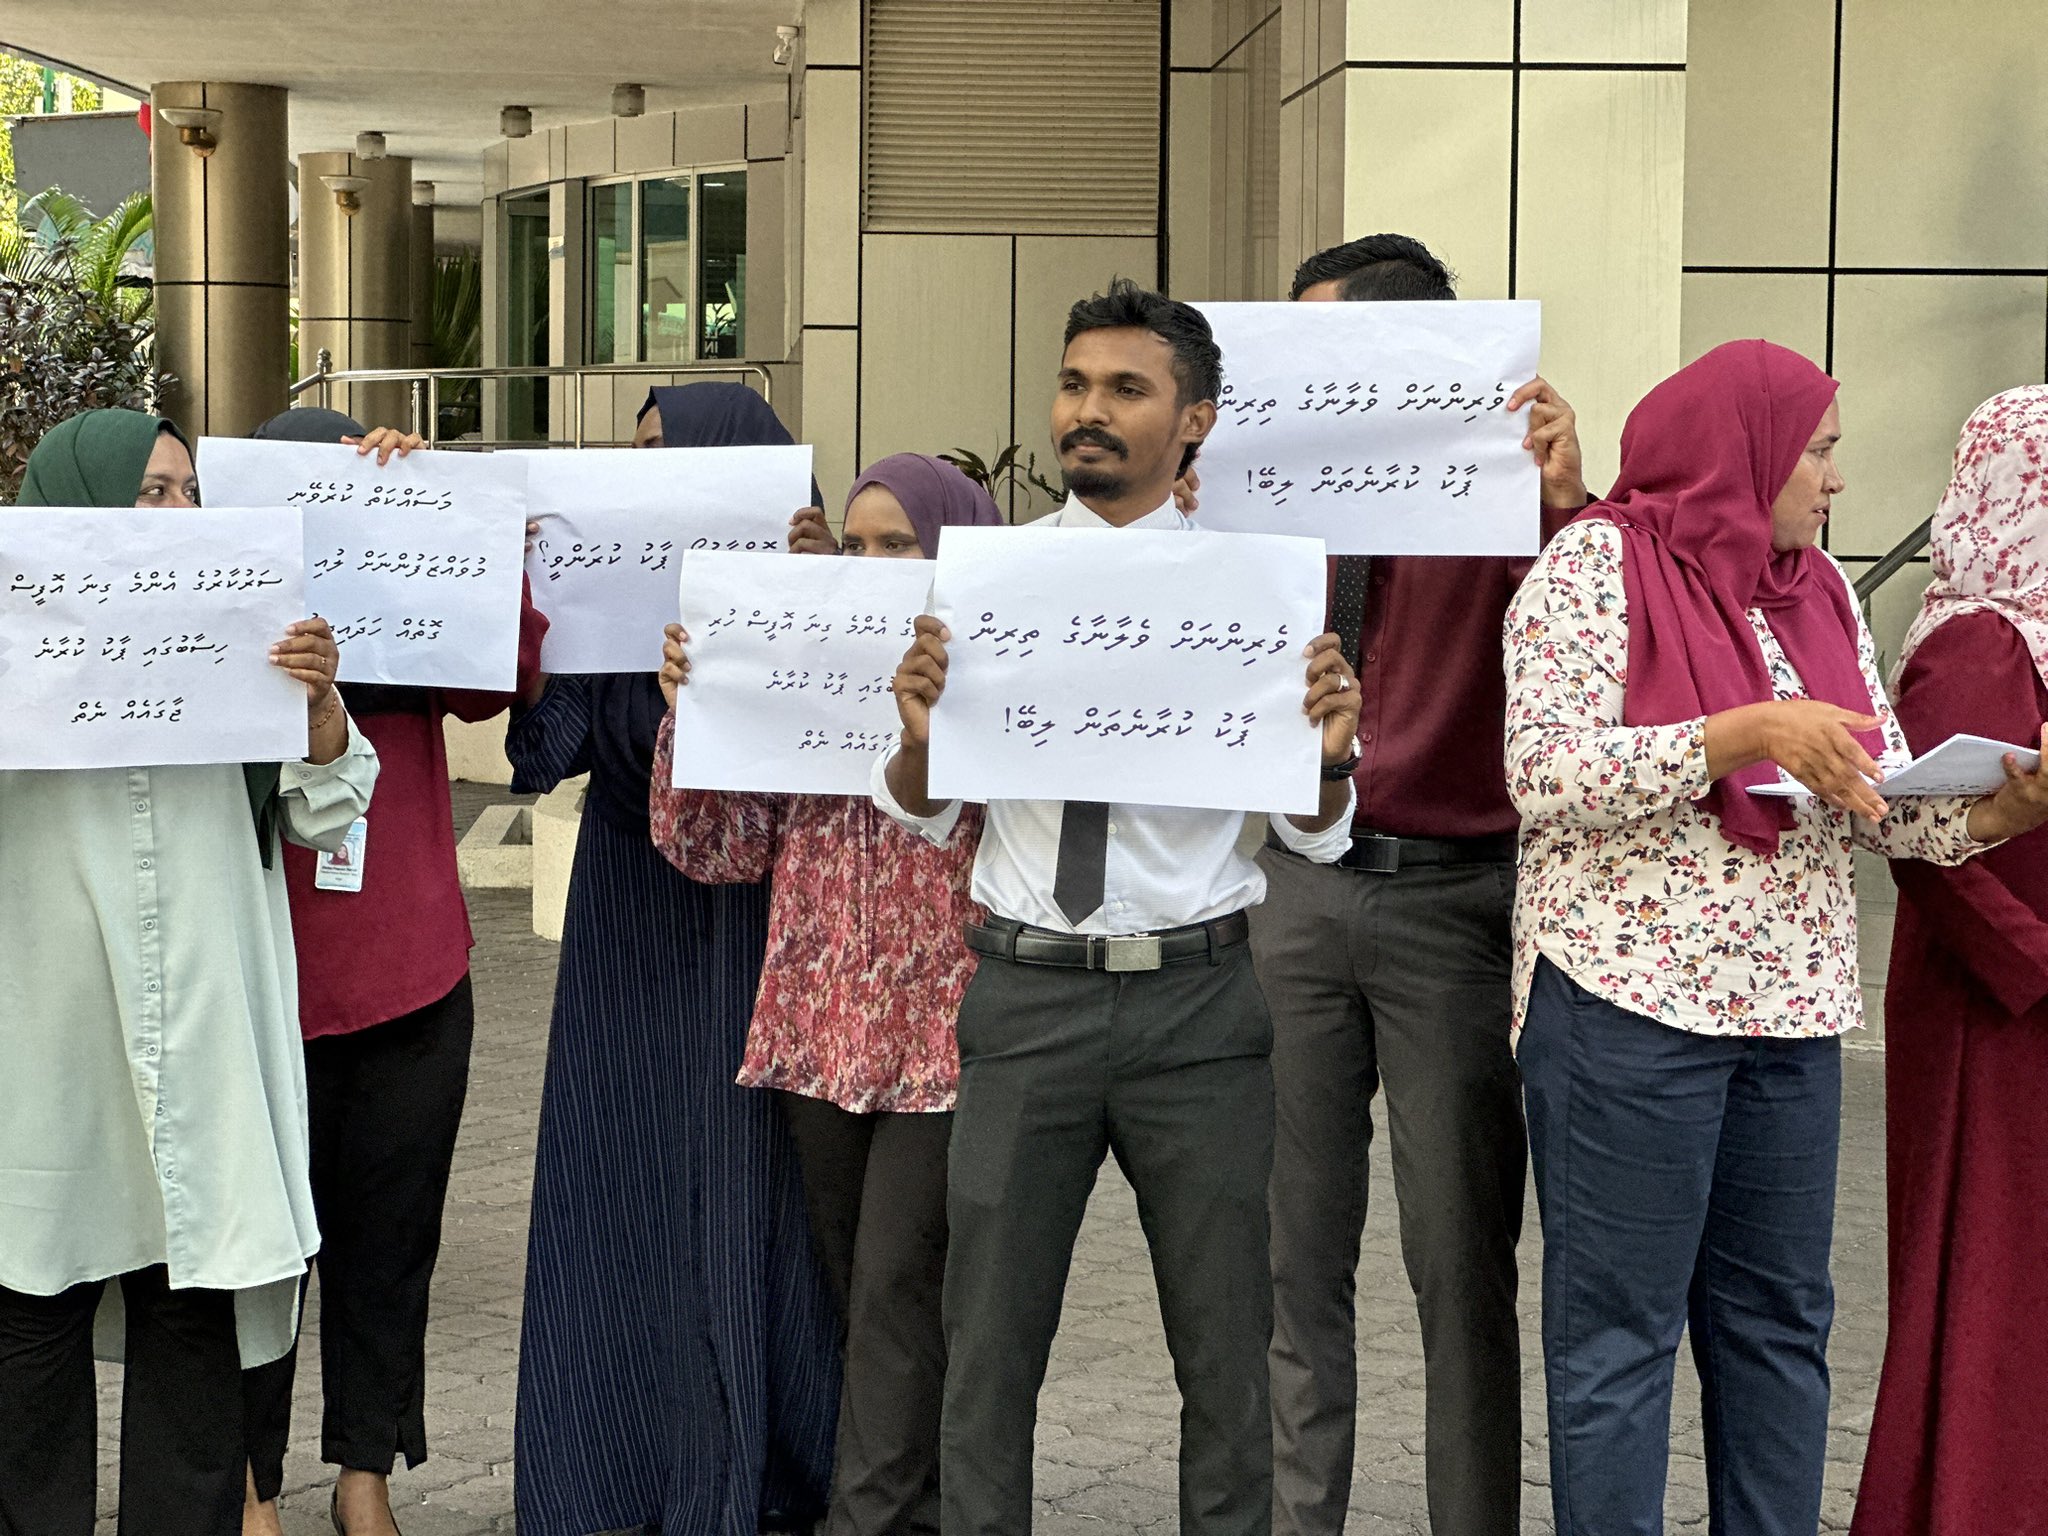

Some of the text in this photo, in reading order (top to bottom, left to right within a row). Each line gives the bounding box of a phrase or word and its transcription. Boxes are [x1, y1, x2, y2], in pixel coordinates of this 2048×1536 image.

[1299, 381, 1378, 416] ވެލާނާގެ
[1397, 382, 1505, 424] ވެރިންނަށް
[1247, 466, 1294, 506] ލިބޭ!
[1440, 463, 1479, 498] ޕާކު
[639, 540, 673, 572] ޕާކު
[10, 573, 66, 607] އޮފީސް
[78, 574, 111, 604] ގިނަ
[129, 571, 176, 593] އެންމެ
[395, 618, 443, 641] ގޮތެއް
[708, 608, 736, 637] ހުރި
[747, 610, 795, 641] އޮފީސް
[803, 614, 831, 642] ގިނަ
[846, 614, 887, 635] އެންމެ
[969, 611, 1040, 658] ތިރިން
[1062, 614, 1150, 651] ވެލާނާގެ
[34, 636, 85, 659] ކުރާނެ
[101, 635, 132, 662] ޕާކު
[1170, 623, 1288, 667] ވެރިންނަށް
[765, 670, 810, 690] ކުރާނެ
[823, 672, 848, 696] ޕާކު
[70, 701, 107, 723] ނެތް
[1004, 704, 1056, 748] ލިބޭ!
[798, 729, 829, 750] ނެތް
[1215, 712, 1257, 748] ޕާކު
